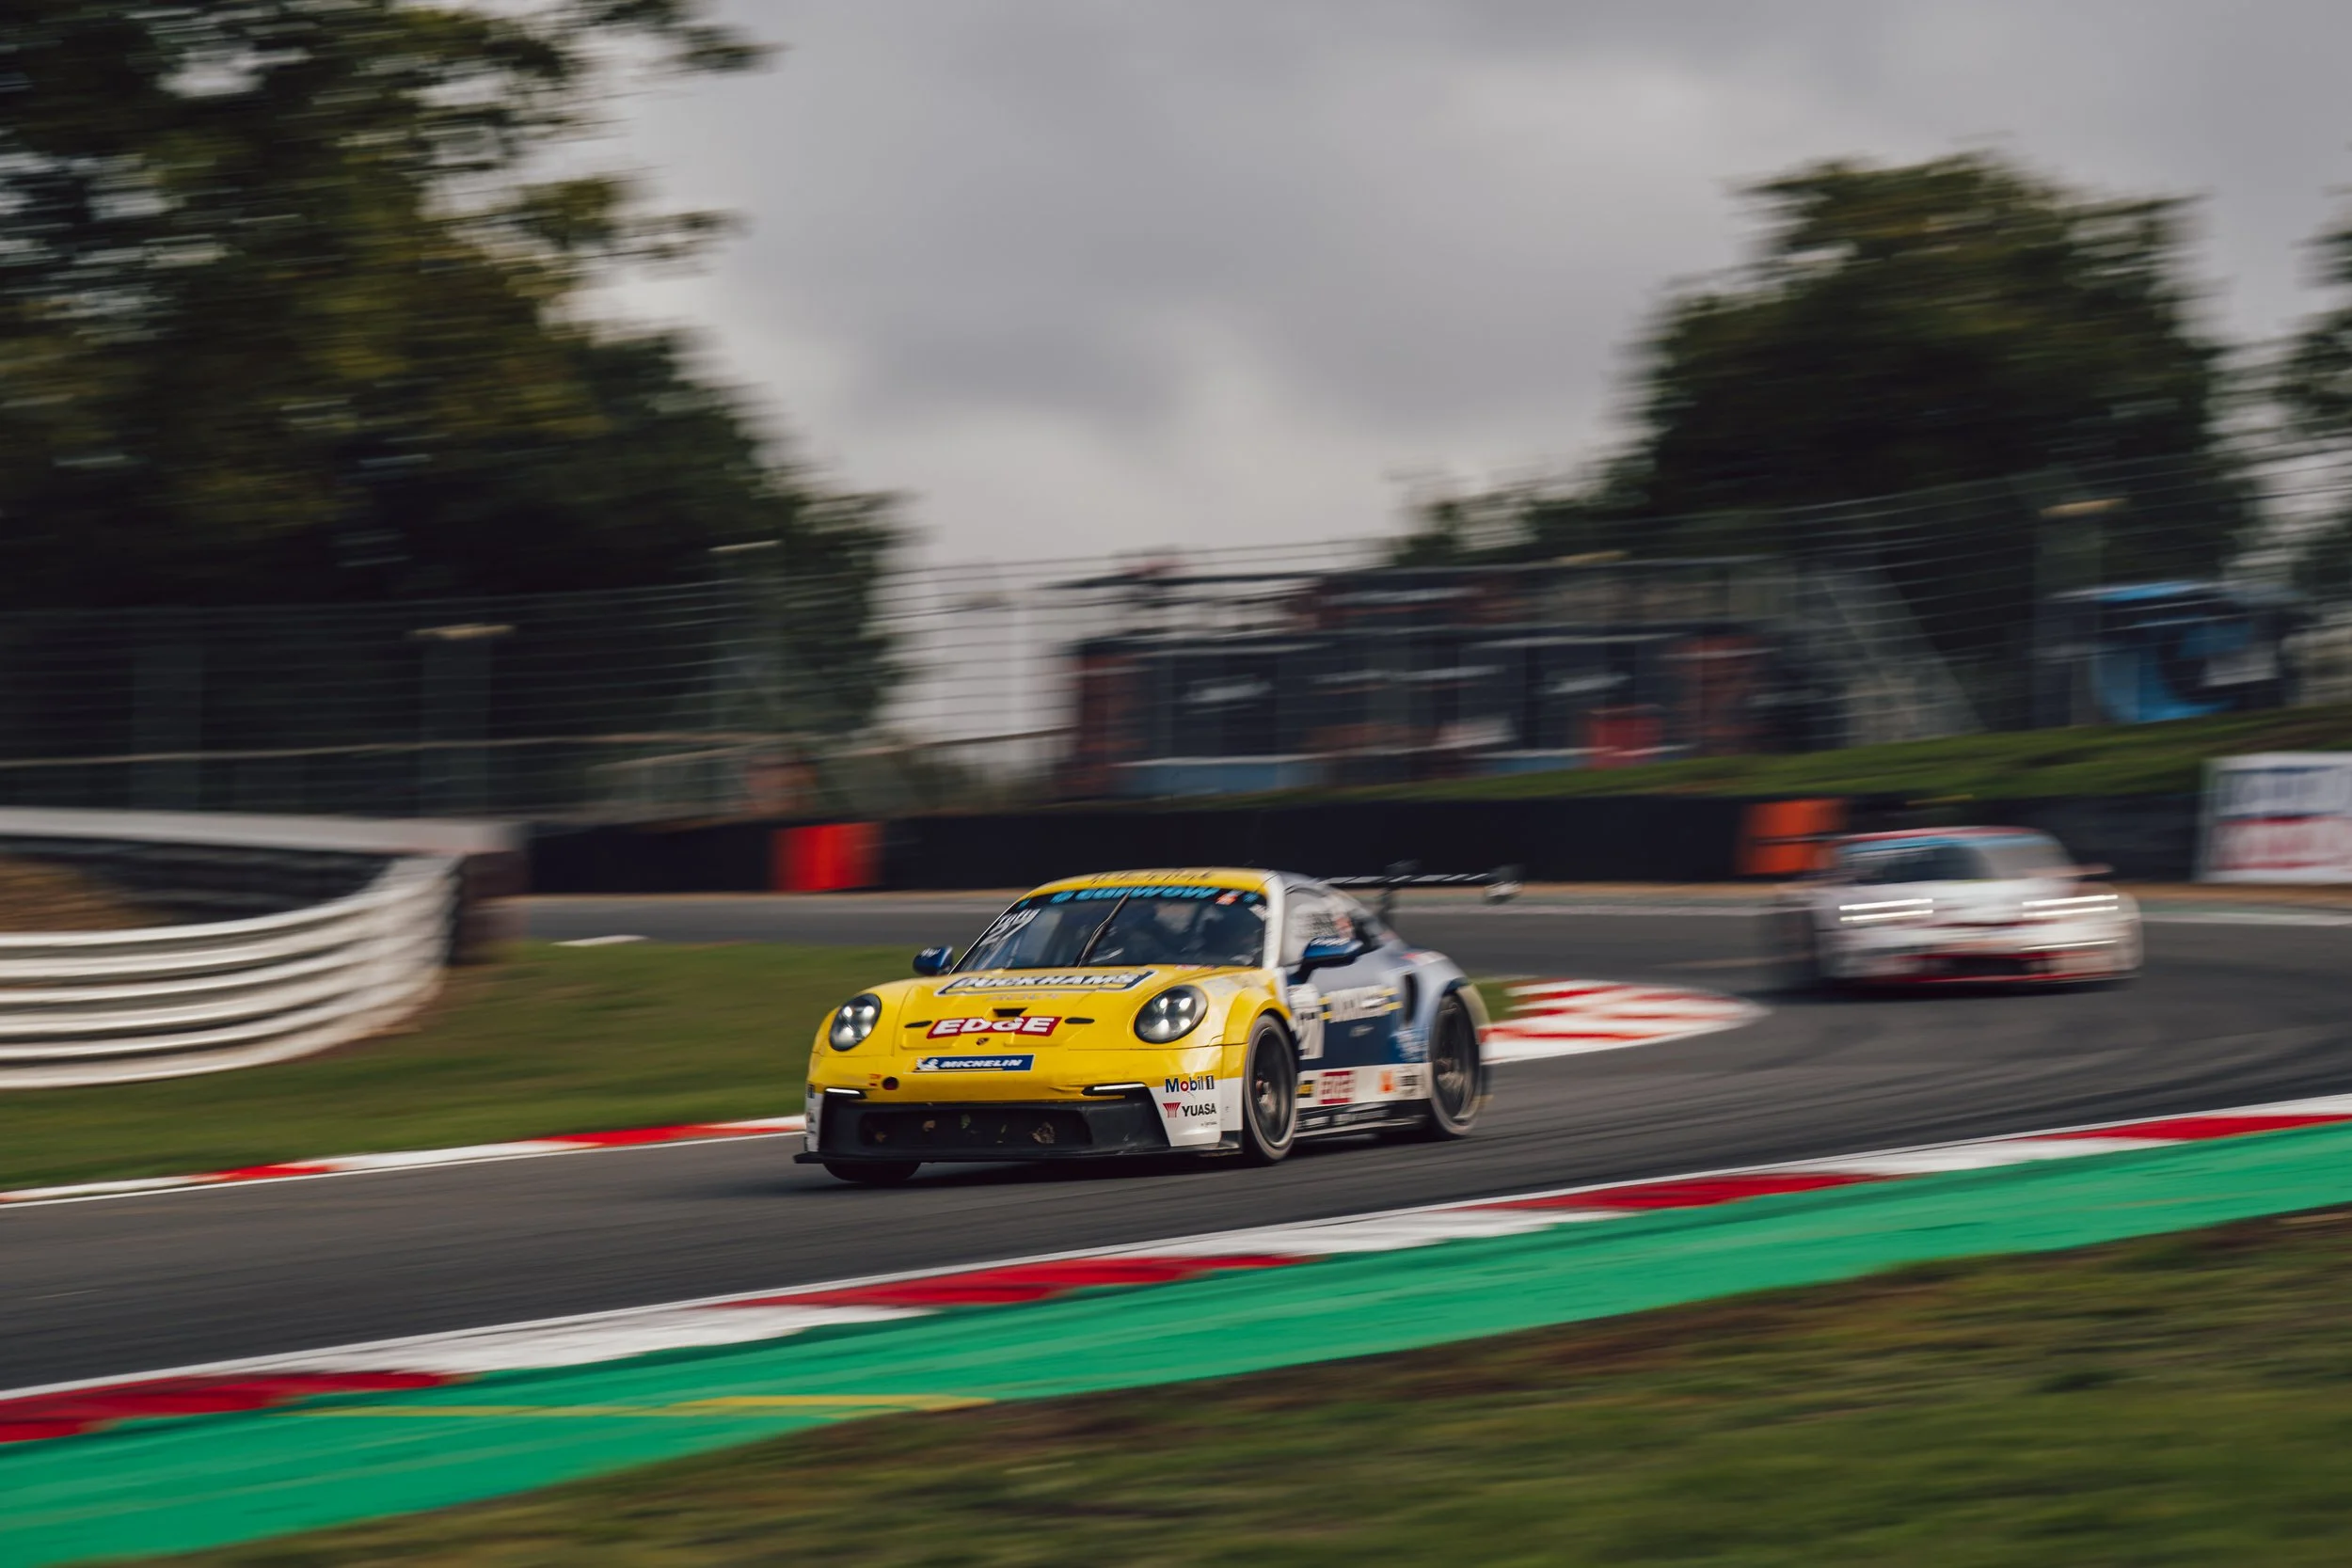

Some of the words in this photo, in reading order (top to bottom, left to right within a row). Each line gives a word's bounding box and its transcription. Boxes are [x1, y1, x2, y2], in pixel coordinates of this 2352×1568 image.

[952, 974, 1139, 988] DUCKHAMS
[932, 1017, 1056, 1035] EDGE
[940, 1059, 1023, 1068] MICHELIN
[1165, 1076, 1203, 1093] Mobil
[1181, 1103, 1217, 1117] YUASA
